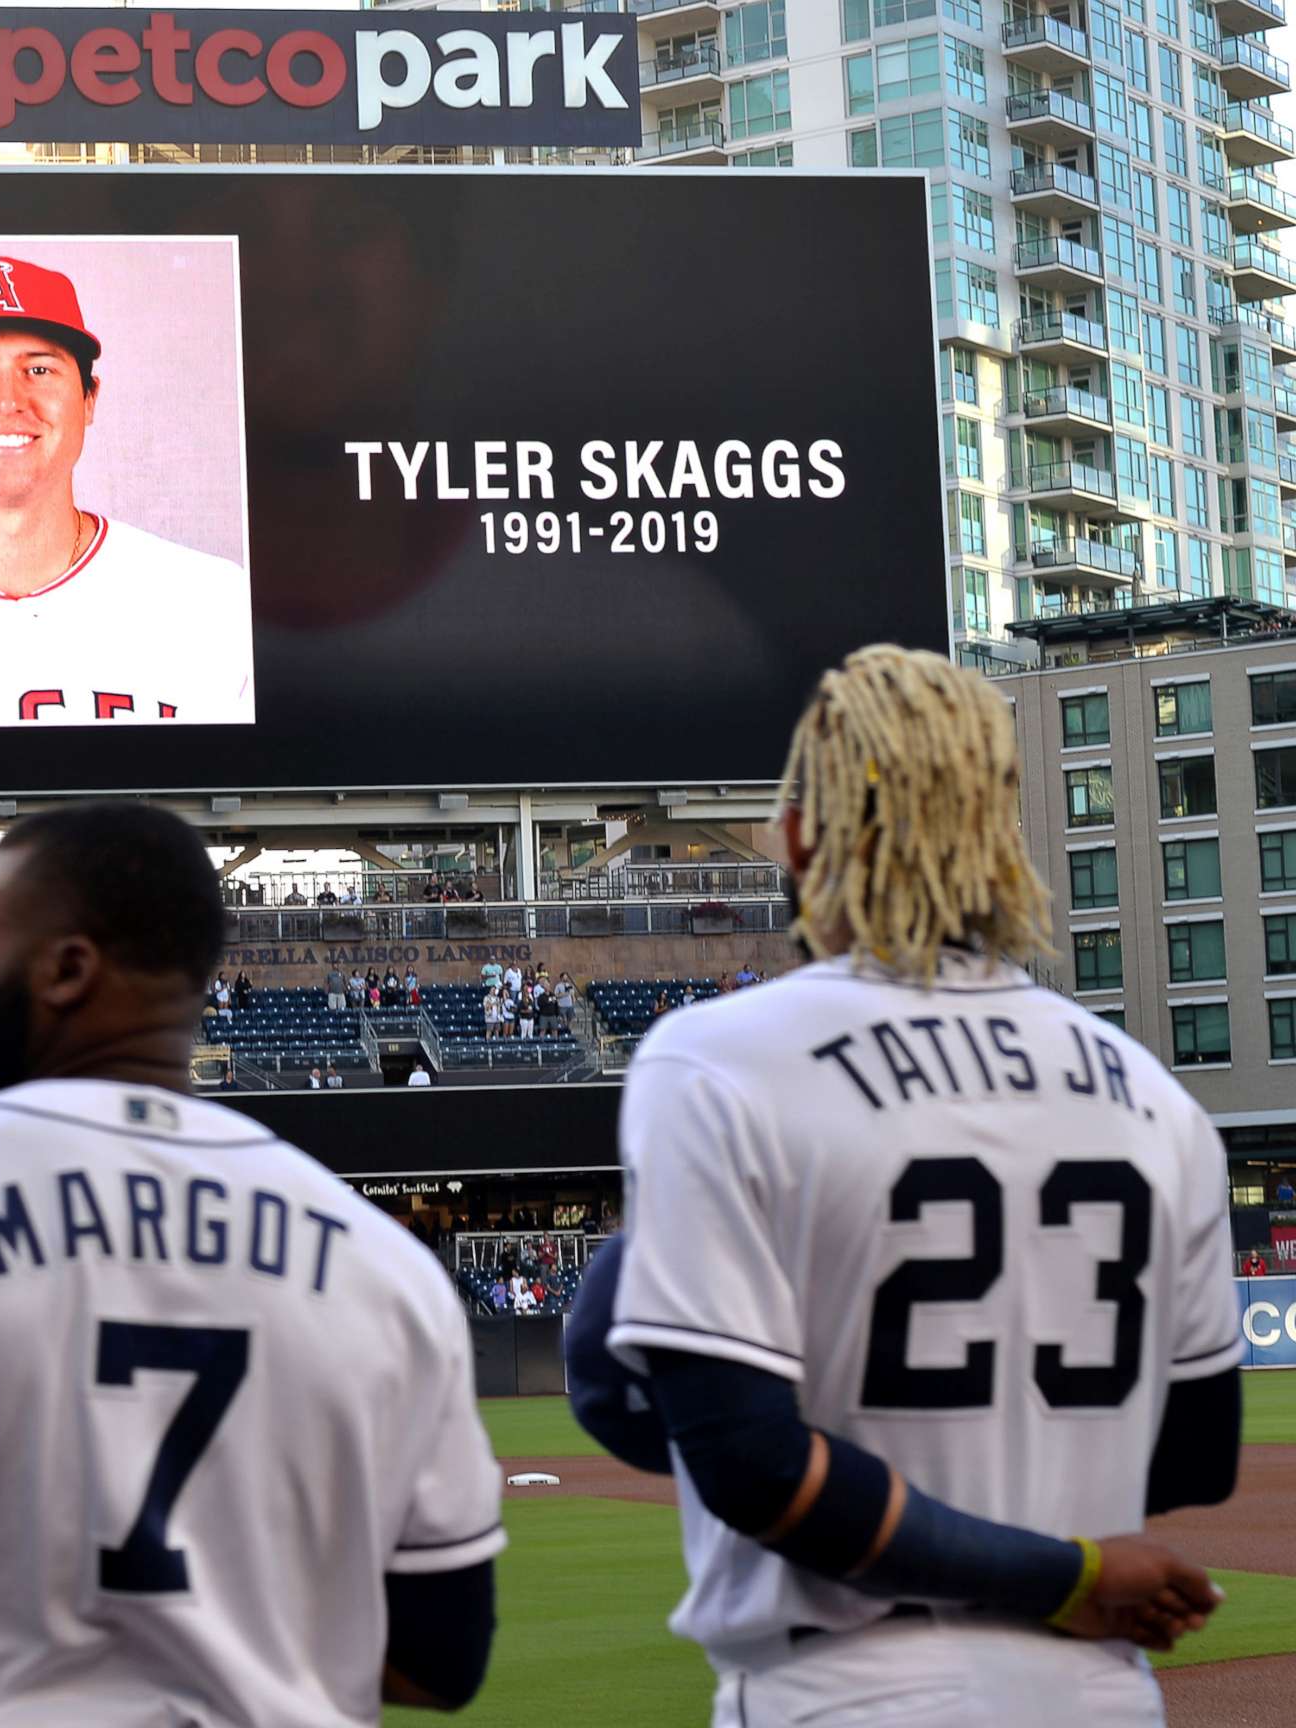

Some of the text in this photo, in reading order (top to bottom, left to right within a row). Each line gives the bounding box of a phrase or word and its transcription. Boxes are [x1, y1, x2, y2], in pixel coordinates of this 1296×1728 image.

[344, 439, 846, 501] TYLER SKAGGS
[480, 510, 720, 554] 1991-2019
[325, 944, 420, 965] JALISCO
[426, 943, 533, 963] LANDING
[811, 1016, 1155, 1122] TATIS JR.
[859, 1156, 1153, 1410] 23
[94, 1320, 251, 1593] 7
